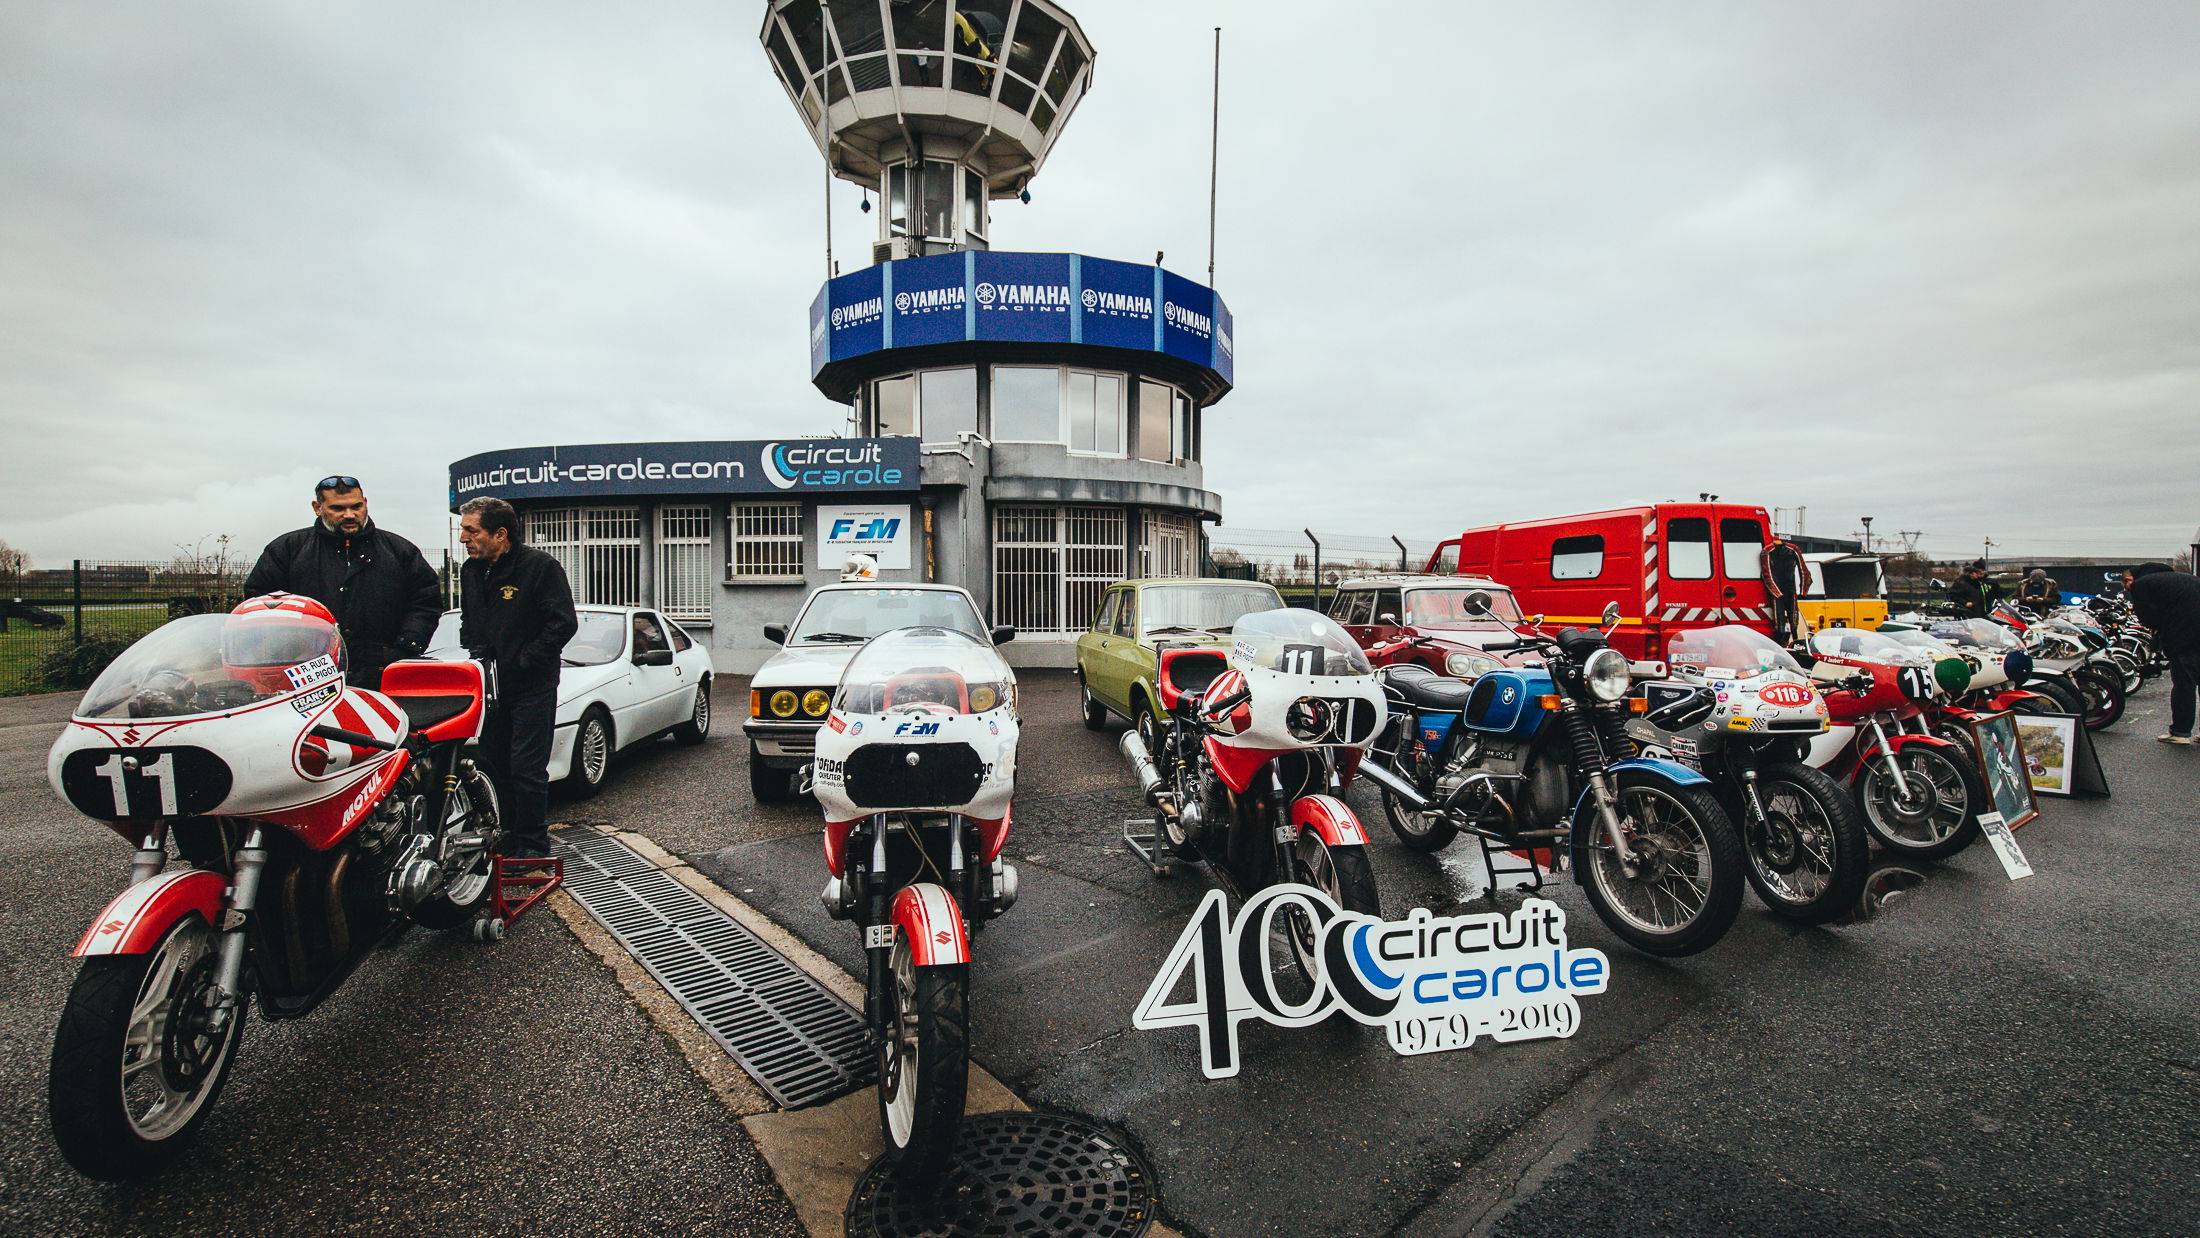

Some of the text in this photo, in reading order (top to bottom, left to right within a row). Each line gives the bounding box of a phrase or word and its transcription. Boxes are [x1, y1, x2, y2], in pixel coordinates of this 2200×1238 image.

[911, 286, 966, 308] YAMAHA
[997, 284, 1070, 305] YAMAHA
[1098, 291, 1153, 314] YAMAHA
[842, 297, 883, 323] YAMAHA
[901, 304, 962, 316] RACING
[1087, 308, 1149, 320] RACING
[1175, 305, 1212, 334] YAMAHA
[835, 315, 880, 331] RACING
[1168, 321, 1209, 339] RACING
[787, 442, 882, 465] circuit
[457, 457, 745, 494] www.circuit-carole.com
[802, 463, 902, 486] carole
[300, 657, 329, 673] R. RUIZ
[307, 665, 337, 683] B. PIGOT
[1286, 649, 1313, 676] 11
[1773, 687, 1800, 702] 116
[1802, 690, 1810, 701] 2
[1904, 667, 1934, 700] 15
[294, 687, 330, 707] FRANCE
[1731, 719, 1748, 727] AMAL
[1672, 742, 1697, 753] CHAMPION
[95, 752, 178, 816] 11
[341, 770, 383, 828] MOTUL
[1378, 906, 1561, 962] circuit
[1412, 949, 1604, 1005] carole
[1395, 1013, 1469, 1051] 1979
[1500, 1001, 1573, 1034] 2019
